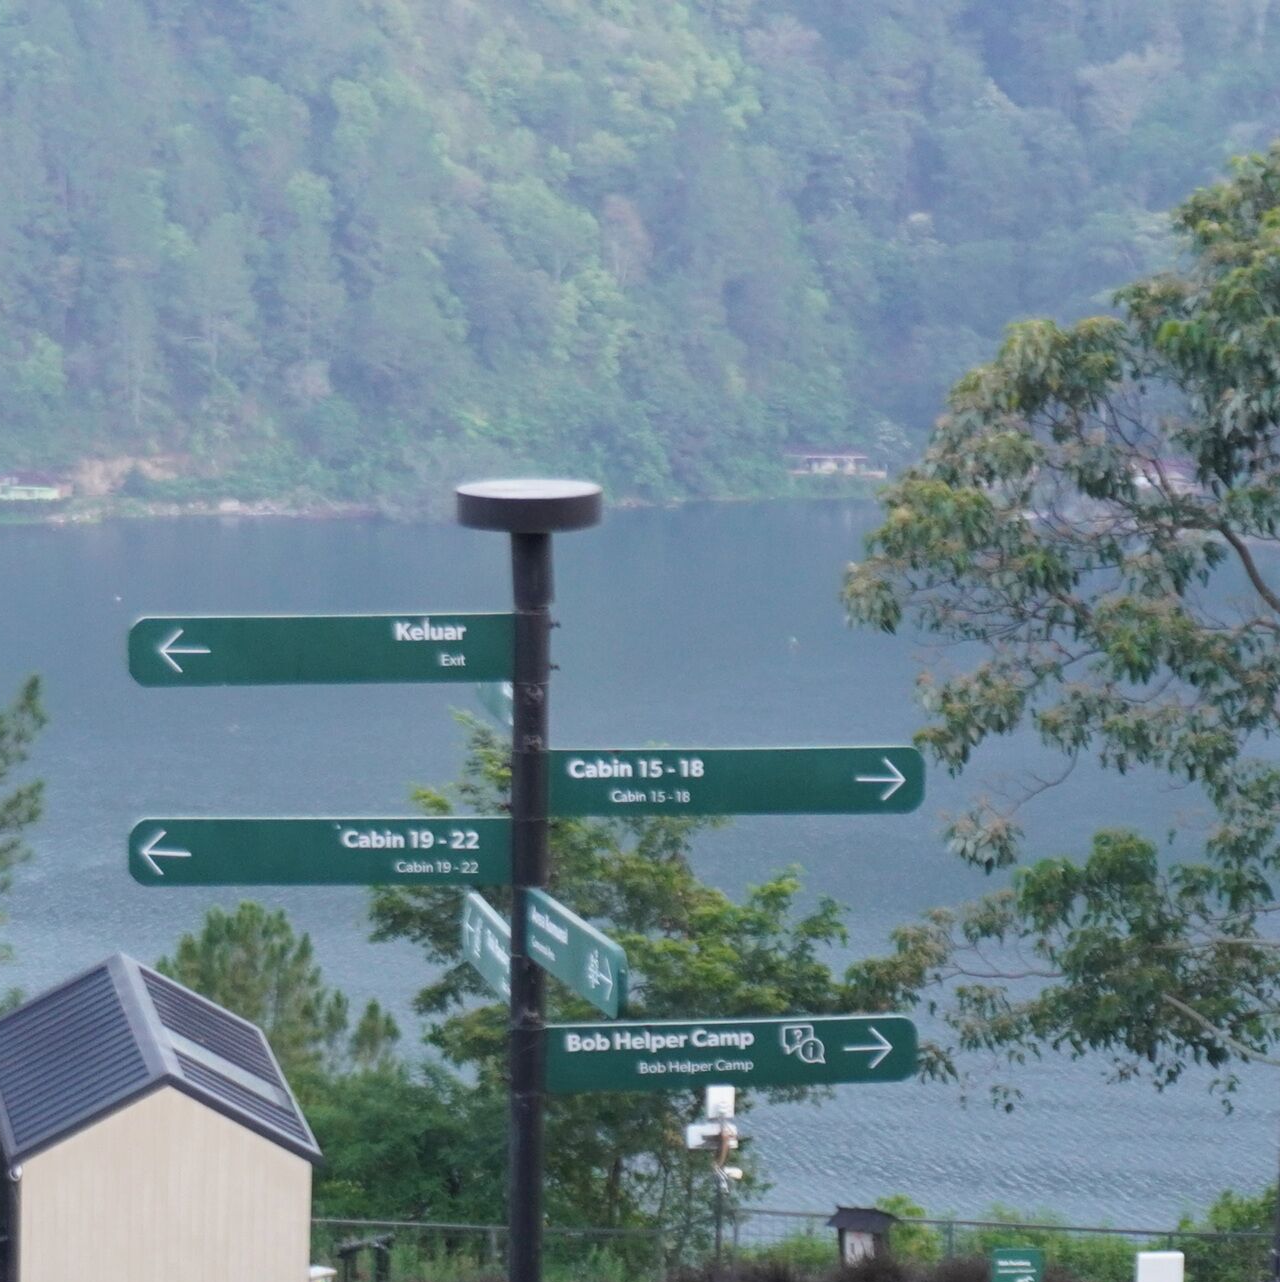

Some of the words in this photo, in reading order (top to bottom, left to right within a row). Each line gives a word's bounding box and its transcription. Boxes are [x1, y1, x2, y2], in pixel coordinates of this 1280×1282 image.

[394, 618, 467, 642] Keluar
[440, 654, 466, 667] Exit
[569, 759, 632, 779] Cabin
[638, 760, 664, 778] 15
[679, 759, 704, 777] 18
[611, 790, 646, 802] Cabin
[651, 790, 665, 802] 15
[676, 790, 690, 802] 18
[341, 829, 405, 849] Cabin
[410, 830, 435, 848] 19
[452, 831, 480, 849] 22
[396, 861, 434, 873] Cabin
[436, 861, 451, 873] 19
[461, 861, 479, 873] 22
[566, 1033, 611, 1052] Bob
[614, 1030, 687, 1053] Helper
[691, 1028, 754, 1048] Camp
[639, 1062, 666, 1074] Bob
[668, 1060, 712, 1074] Helper
[715, 1060, 754, 1073] Camp
